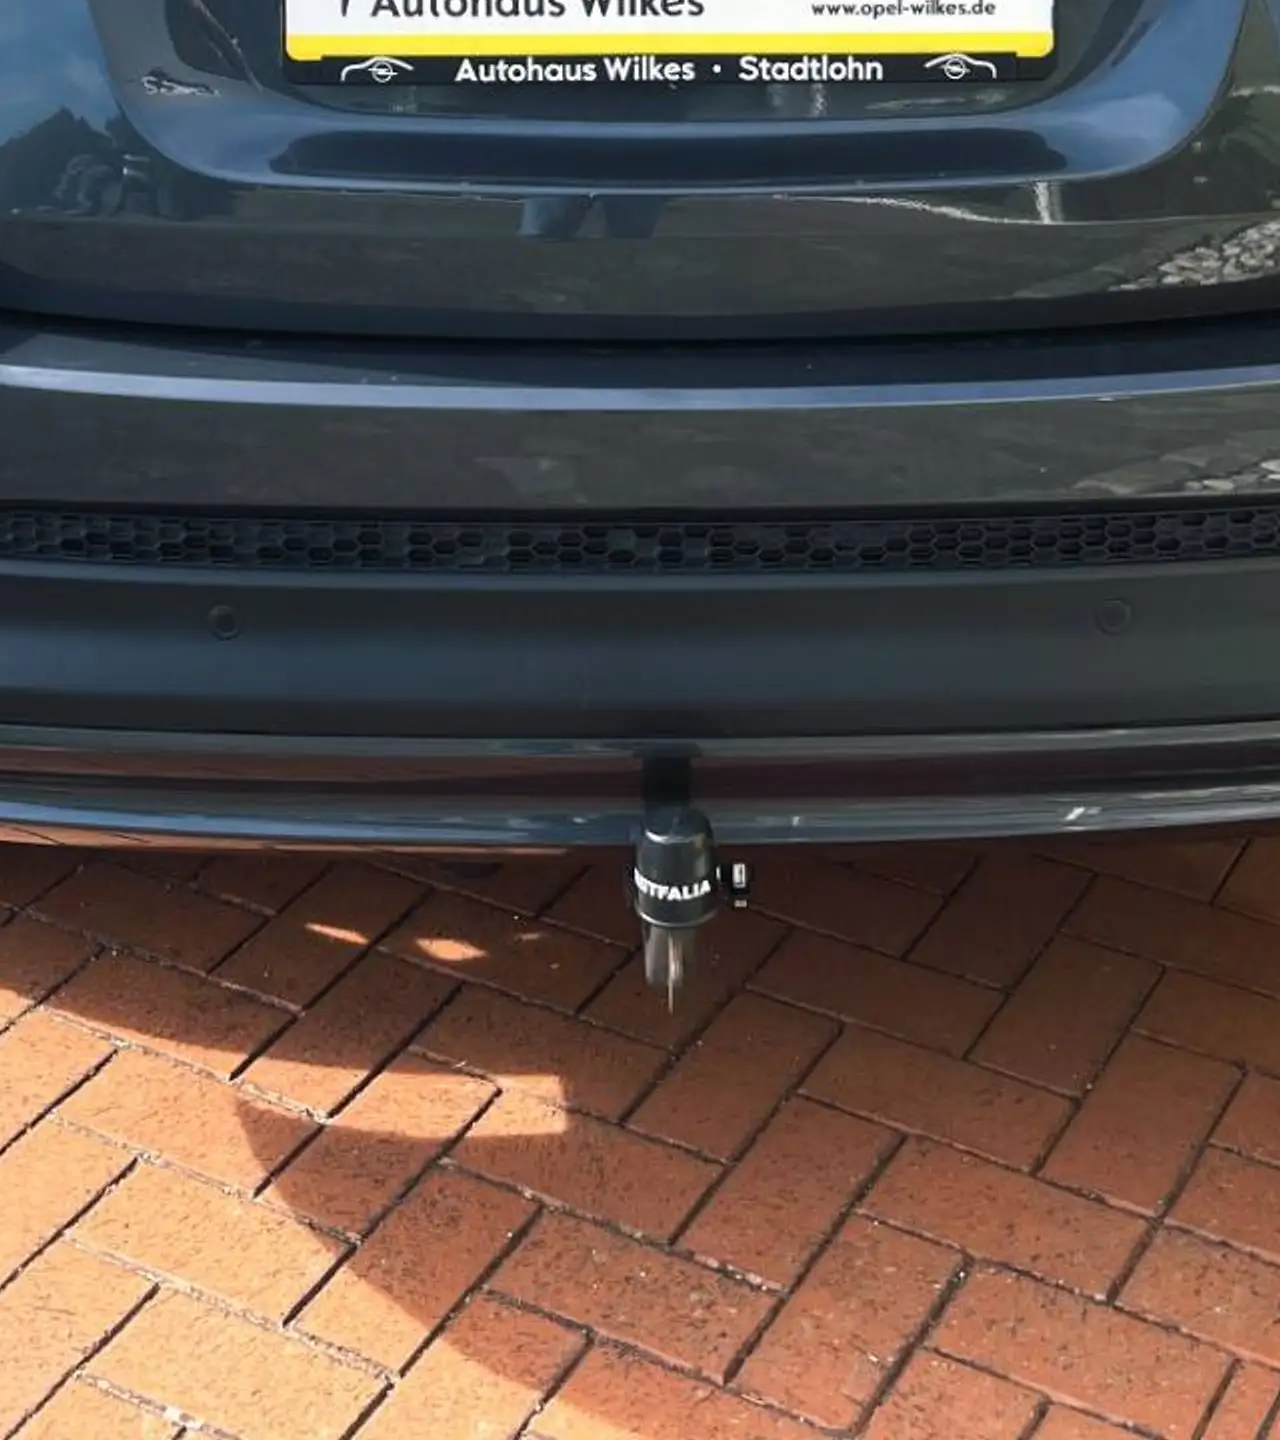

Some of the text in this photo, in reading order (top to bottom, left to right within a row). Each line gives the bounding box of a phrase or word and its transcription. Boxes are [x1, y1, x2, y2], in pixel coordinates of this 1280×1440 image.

[454, 55, 884, 83] Autohaus Wilkes Stadtlohn
